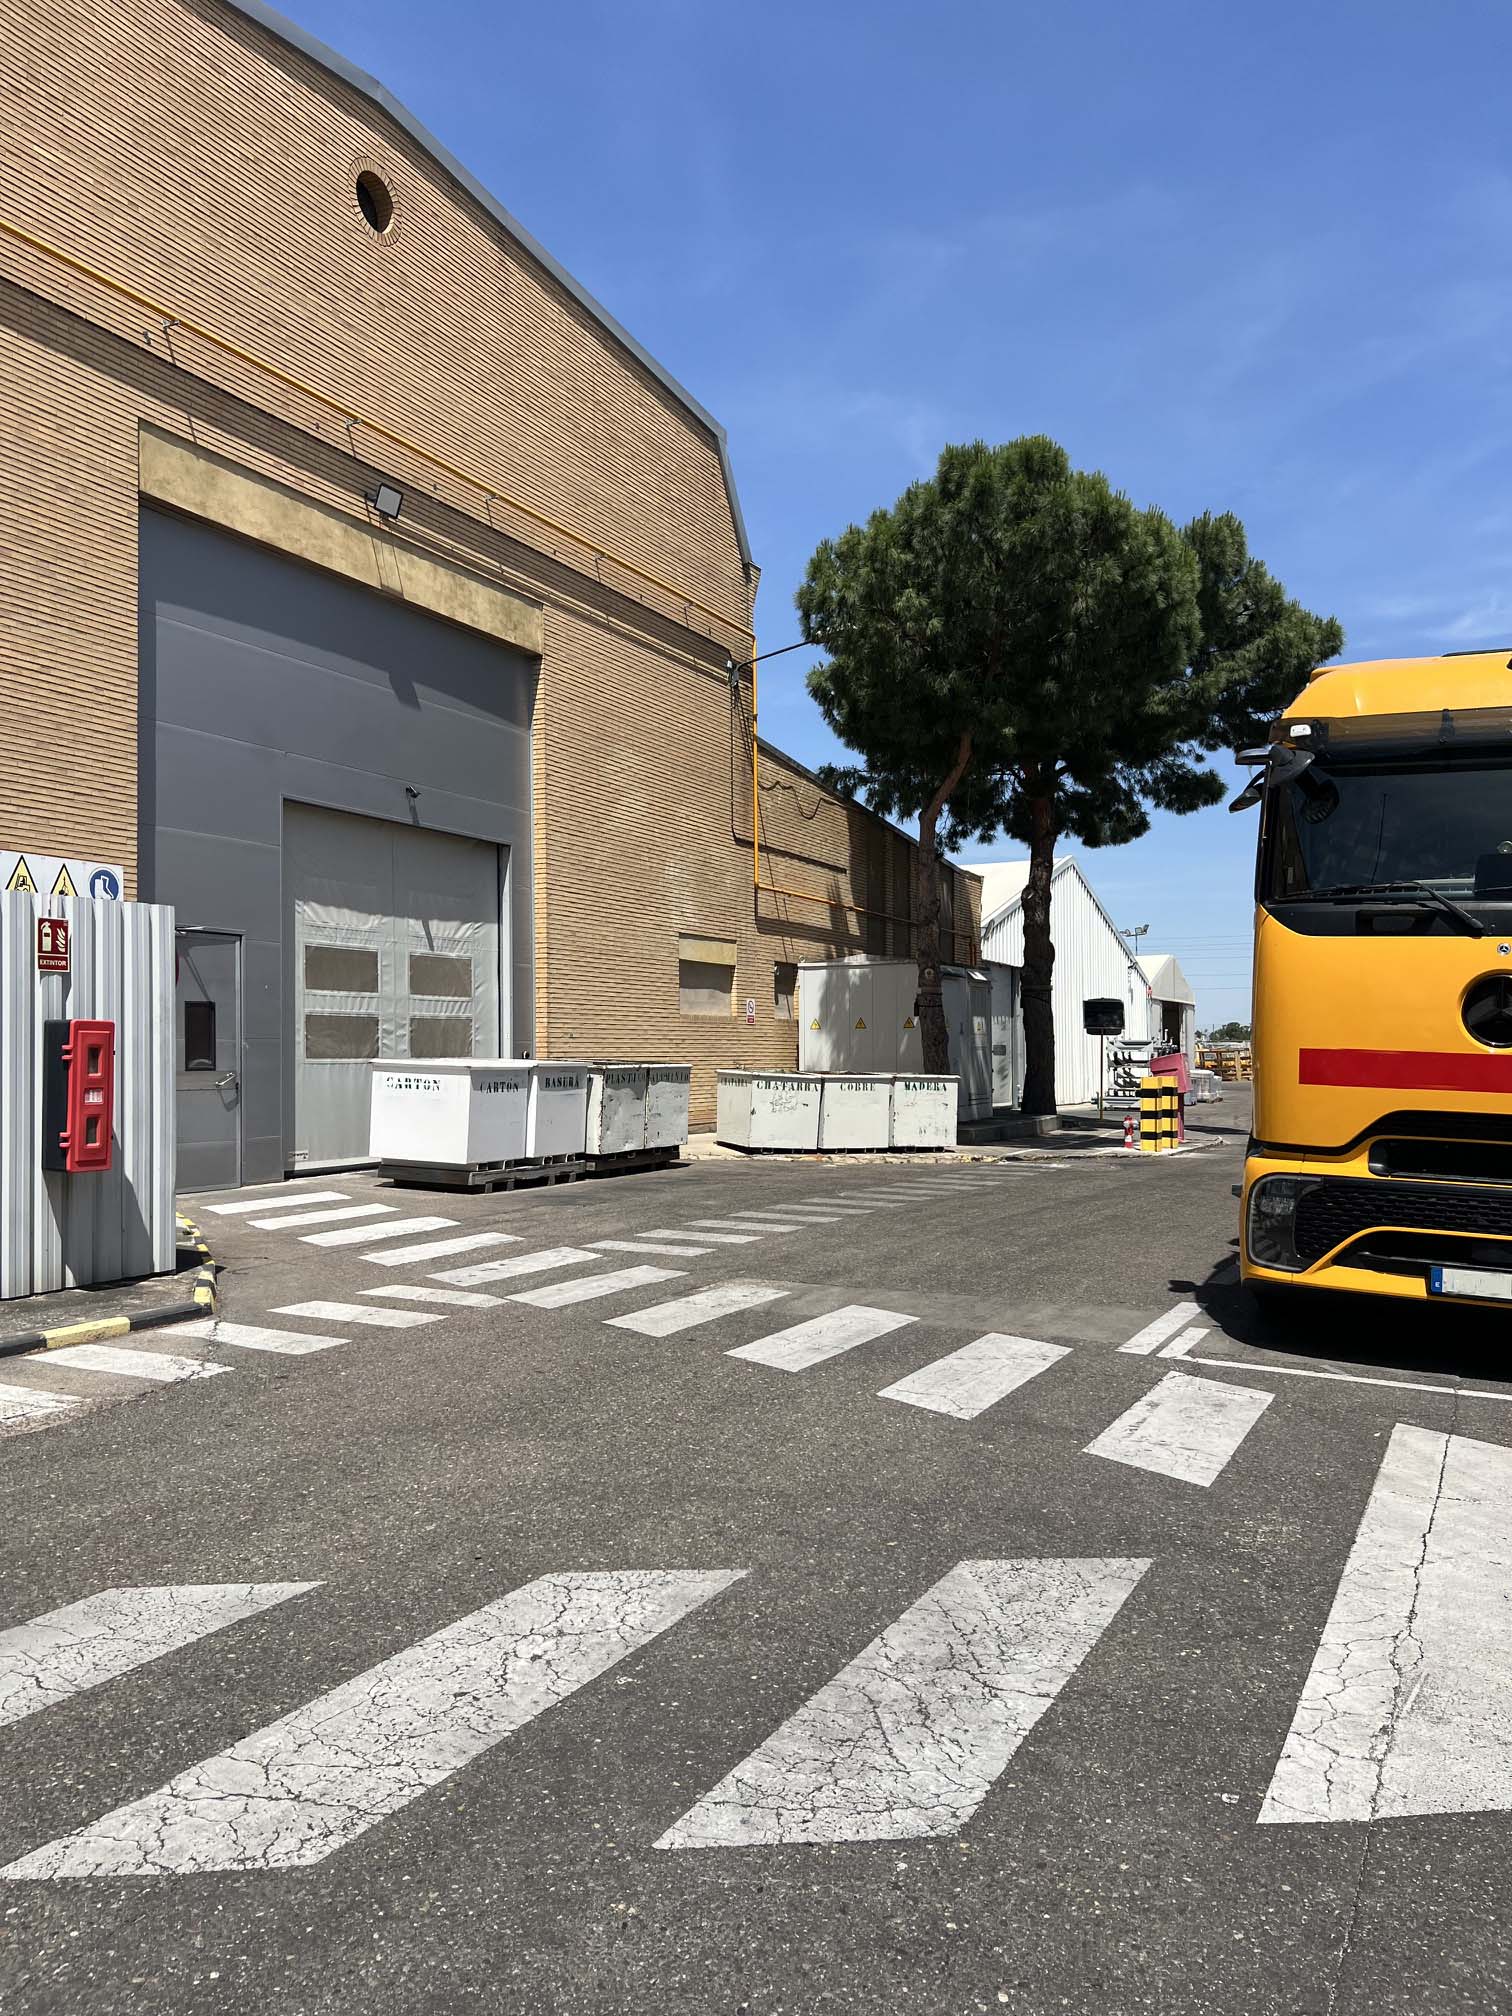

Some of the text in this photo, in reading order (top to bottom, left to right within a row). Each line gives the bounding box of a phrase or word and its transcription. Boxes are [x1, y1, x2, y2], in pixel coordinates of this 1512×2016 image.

[756, 1080, 819, 1092] CHATARRA
[840, 1082, 876, 1092] COBRE
[904, 1081, 948, 1092] MADERA
